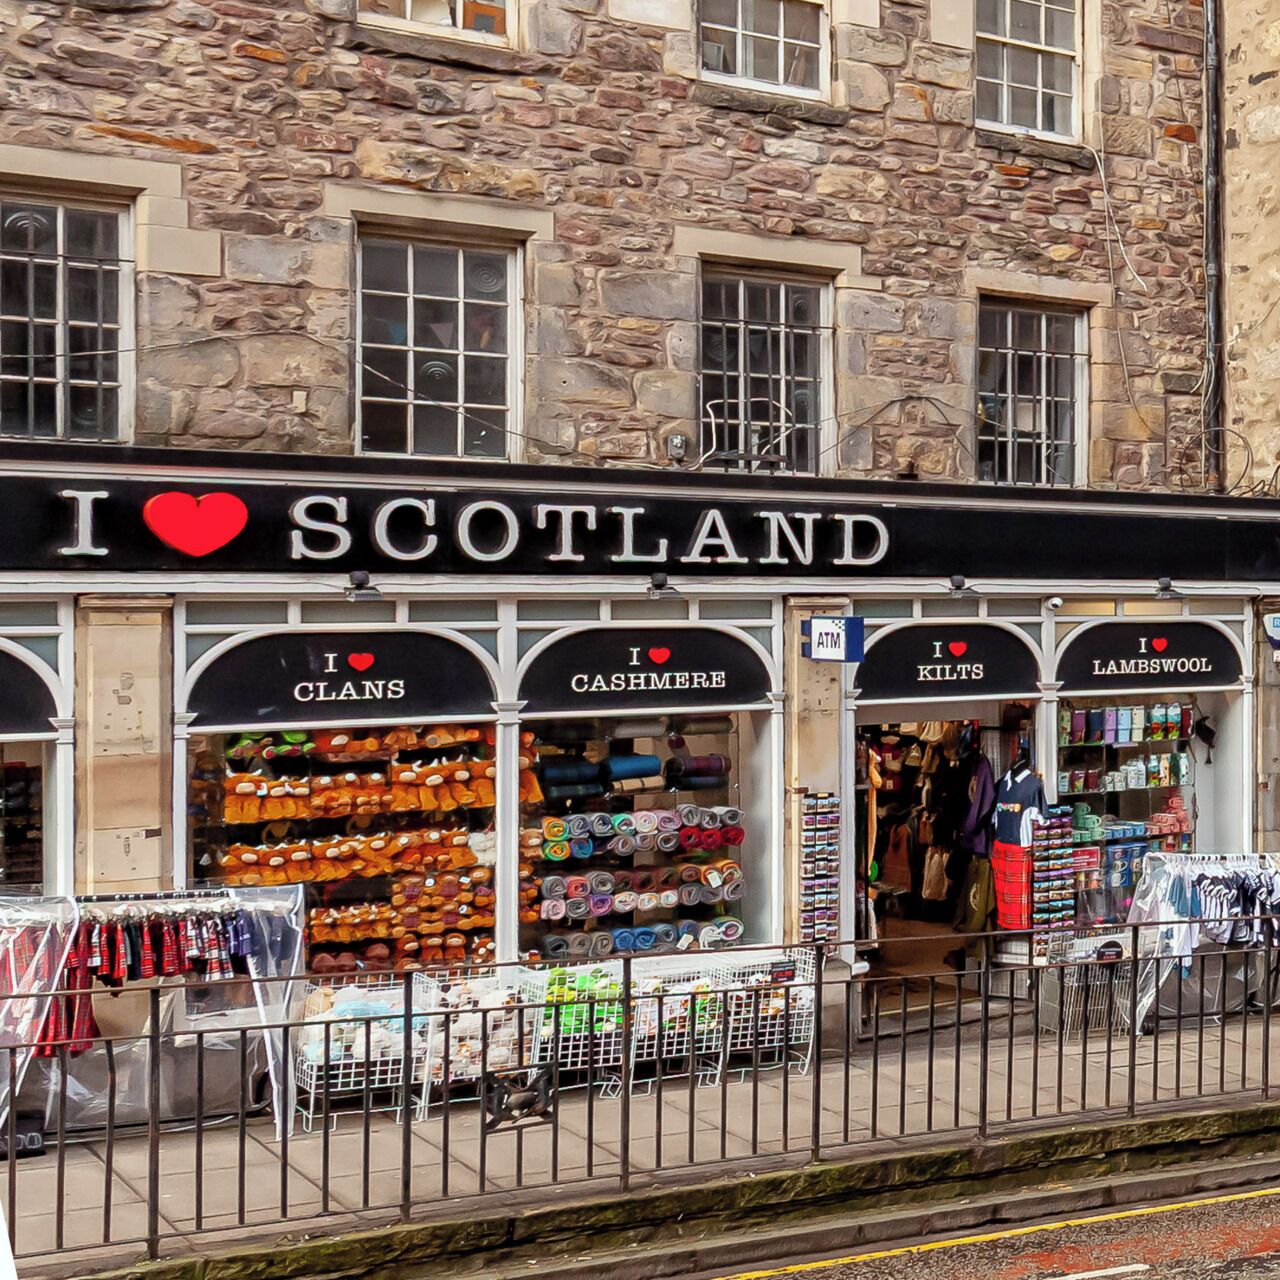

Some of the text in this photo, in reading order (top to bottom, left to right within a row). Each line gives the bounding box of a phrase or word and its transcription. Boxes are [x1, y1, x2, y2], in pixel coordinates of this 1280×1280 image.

[58, 490, 889, 566] I SCOTLAND
[816, 630, 841, 650] ATM
[1138, 637, 1148, 653] I
[629, 648, 641, 666] I
[932, 641, 943, 659] I
[324, 653, 338, 673] I
[916, 663, 984, 681] KILTS
[1093, 657, 1212, 676] LAMBSWOOL
[294, 679, 405, 702] CLANS
[570, 671, 726, 693] CASHMERE
